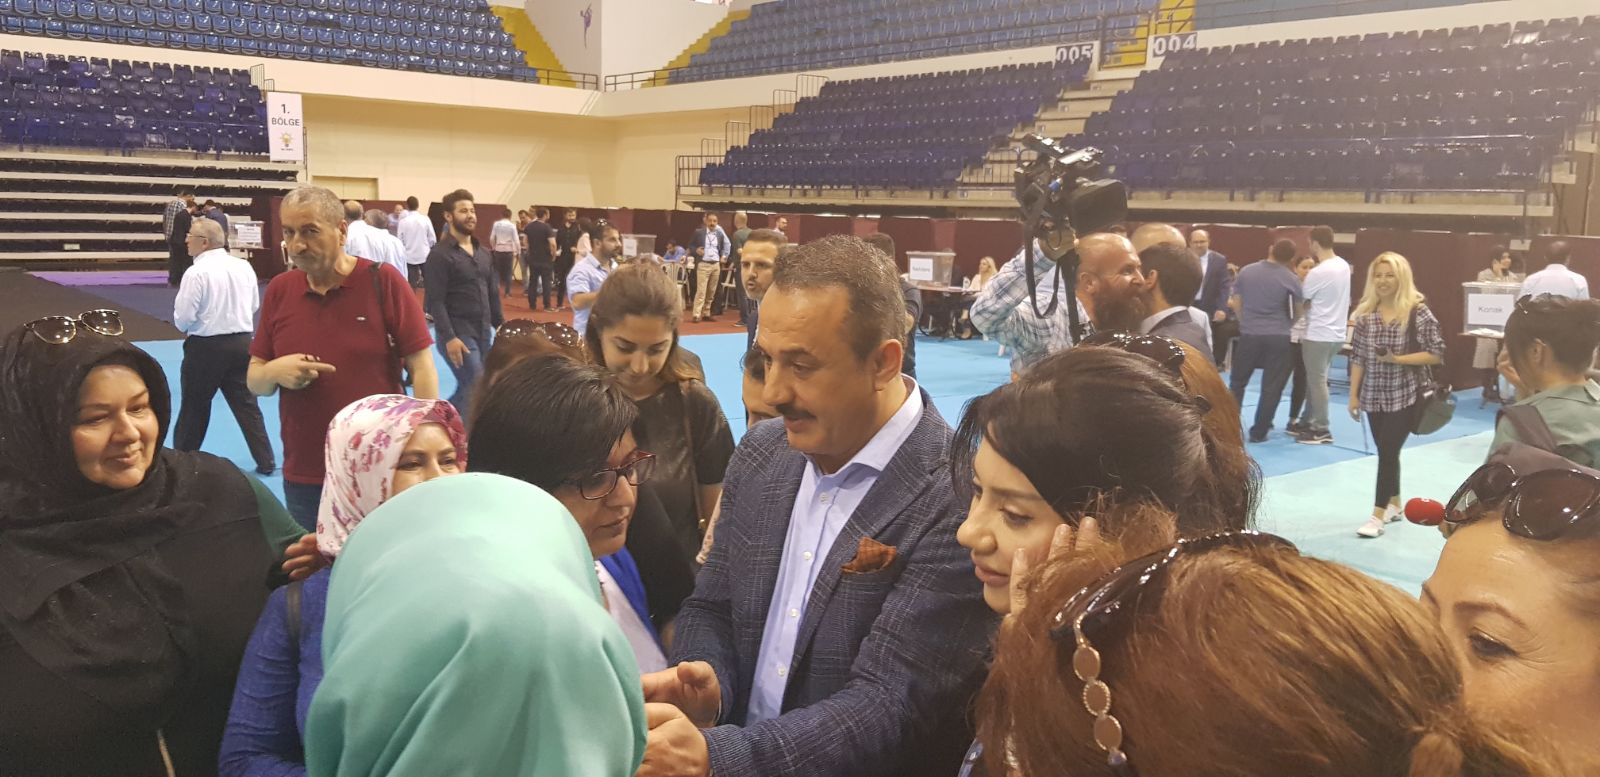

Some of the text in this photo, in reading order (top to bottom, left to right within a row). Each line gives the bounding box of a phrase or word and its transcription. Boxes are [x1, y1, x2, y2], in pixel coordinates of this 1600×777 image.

[1154, 34, 1197, 55] 004
[1056, 45, 1092, 63] 005
[281, 104, 290, 114] 1.
[271, 117, 300, 127] BÖLGE
